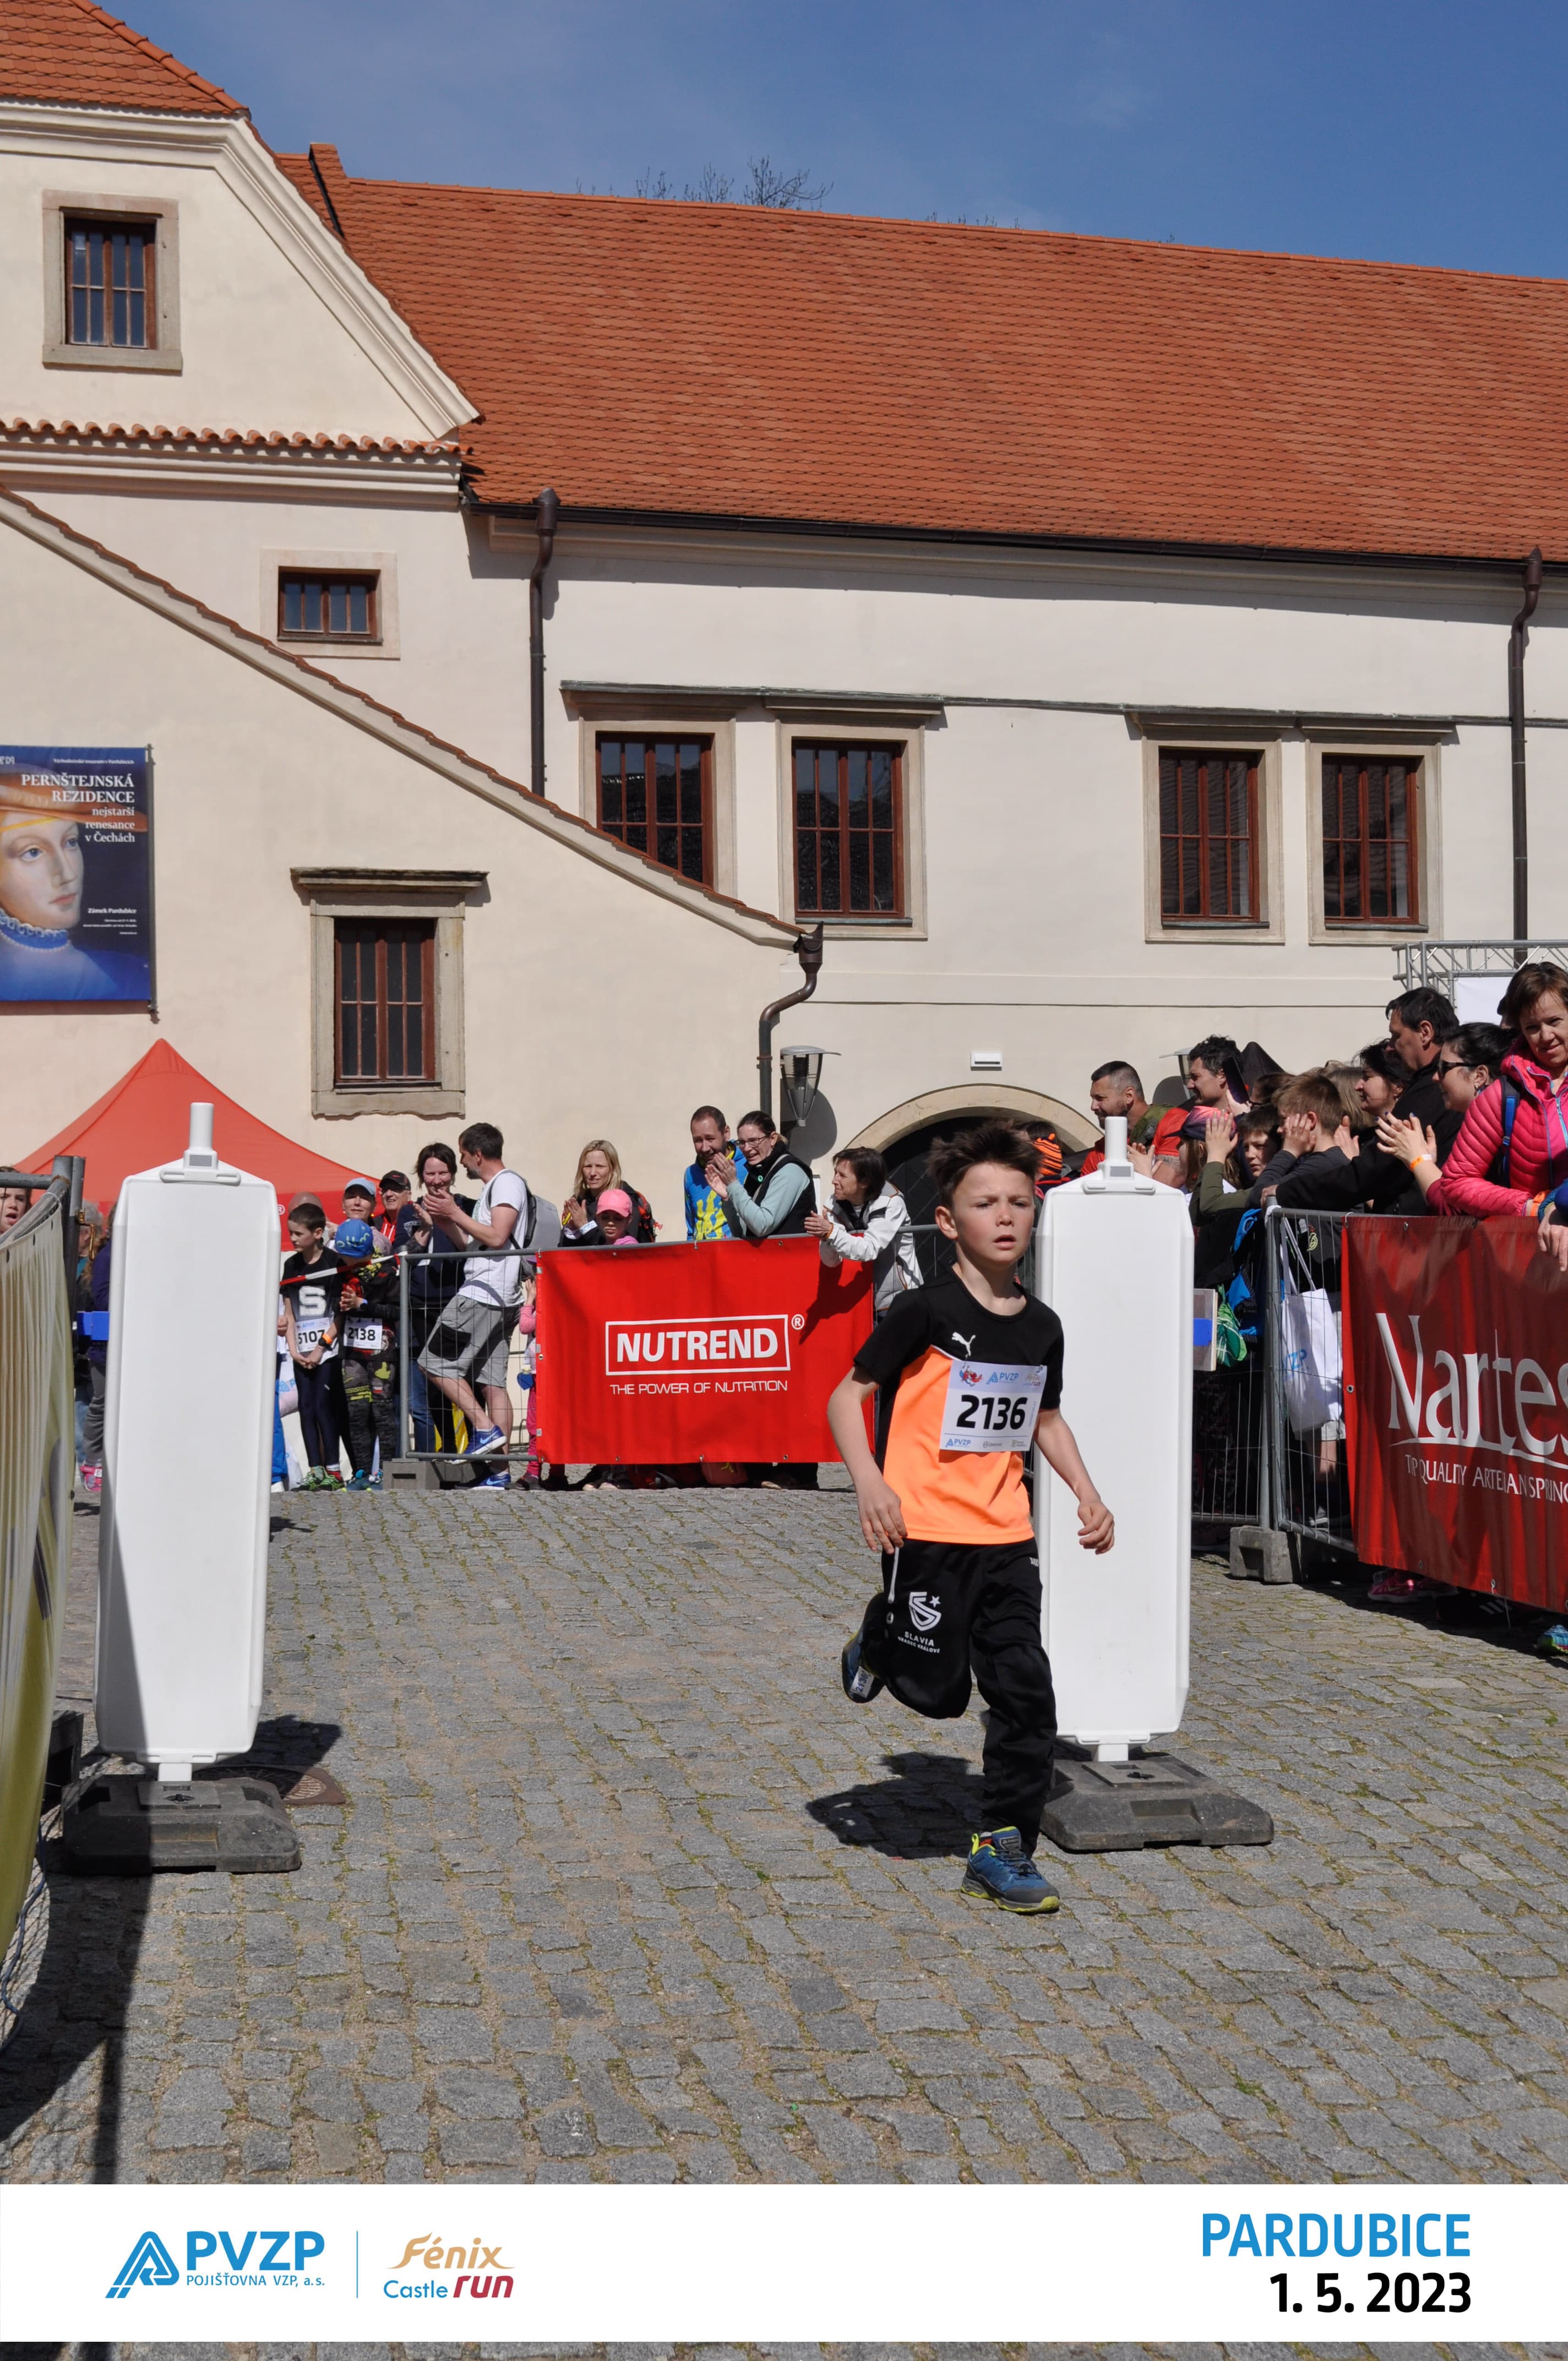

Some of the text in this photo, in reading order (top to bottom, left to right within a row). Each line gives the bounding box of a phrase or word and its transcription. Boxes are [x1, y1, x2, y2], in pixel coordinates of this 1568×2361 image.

[21, 773, 134, 787] PERNŠTEJNSKÁ
[52, 791, 135, 803] REZIDENCE
[92, 806, 134, 818] nejstarší
[85, 821, 135, 830] renesance
[93, 831, 135, 842] Čechách
[347, 1326, 375, 1341] 2138
[617, 1328, 778, 1362] NUTREND
[999, 1372, 1019, 1381] PVZP
[610, 1380, 787, 1395] THE POWER OF NUTRITION
[956, 1395, 1028, 1430] 2136
[904, 1630, 934, 1647] SLAVIA
